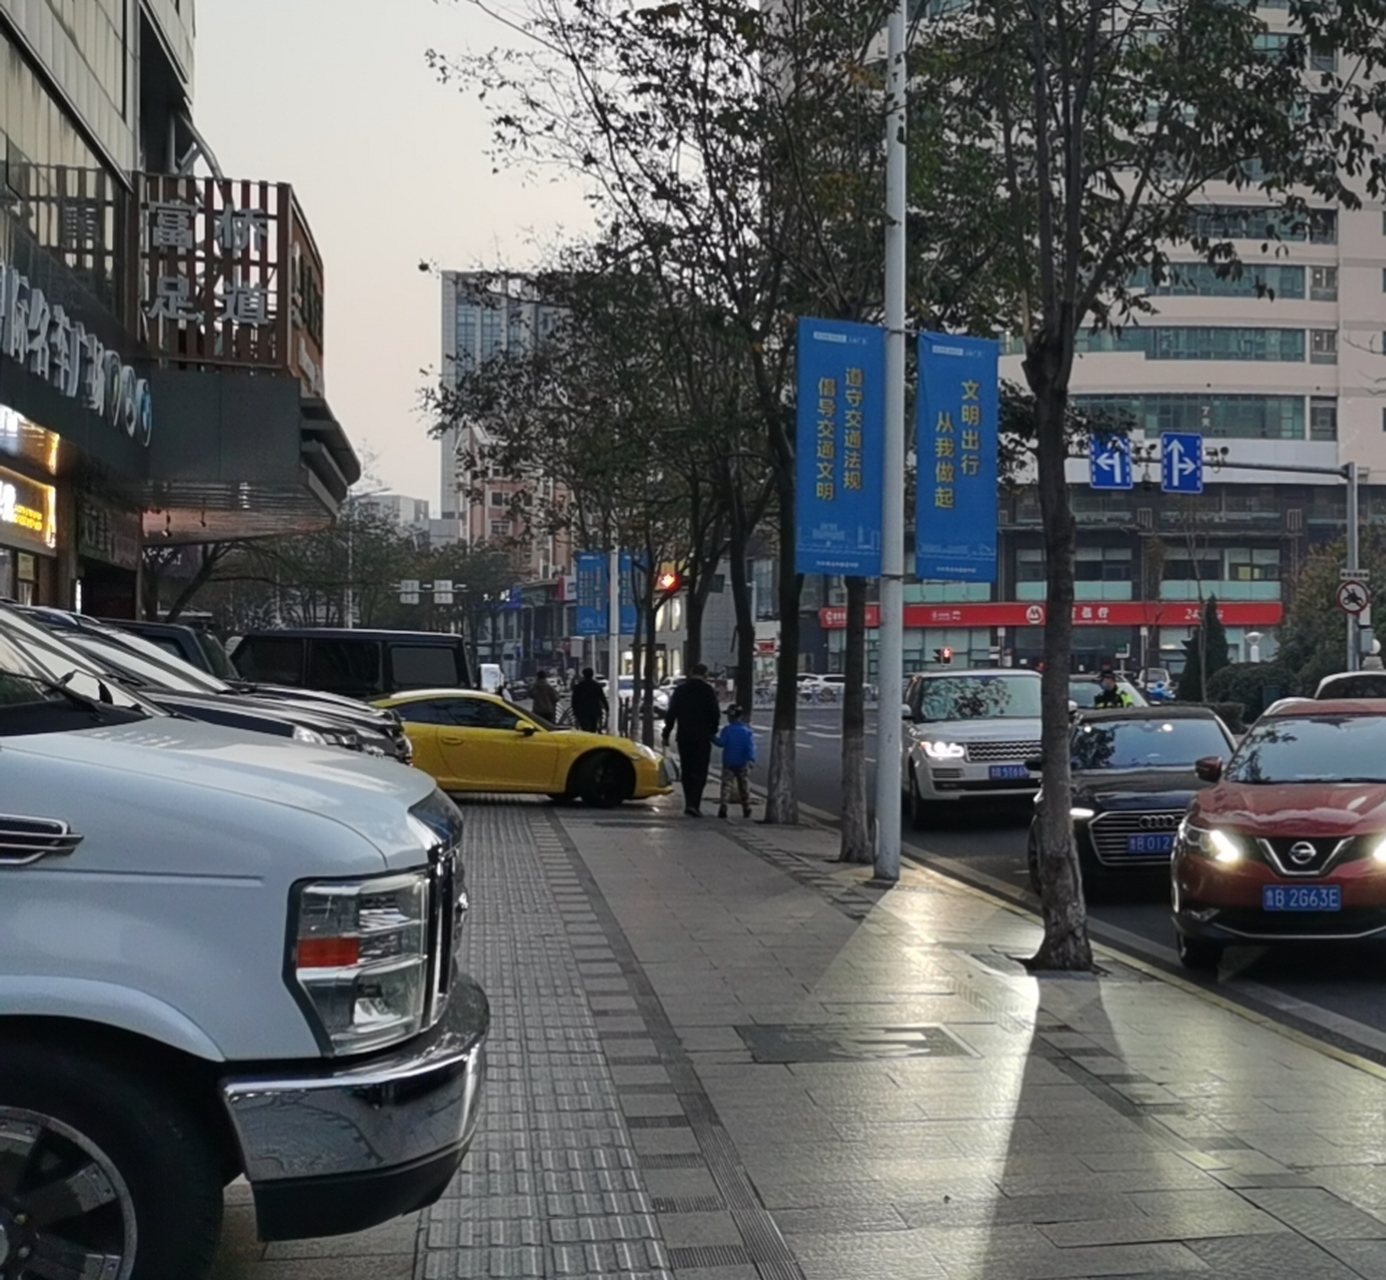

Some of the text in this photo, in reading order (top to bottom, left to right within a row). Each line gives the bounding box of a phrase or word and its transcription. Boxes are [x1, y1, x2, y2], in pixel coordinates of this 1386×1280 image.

[147, 276, 269, 324] 足道
[816, 377, 837, 501] 倡导交通文明
[843, 367, 864, 490] 遵守交通法规
[935, 410, 954, 508] 从我做起
[961, 379, 980, 476] 文明出行
